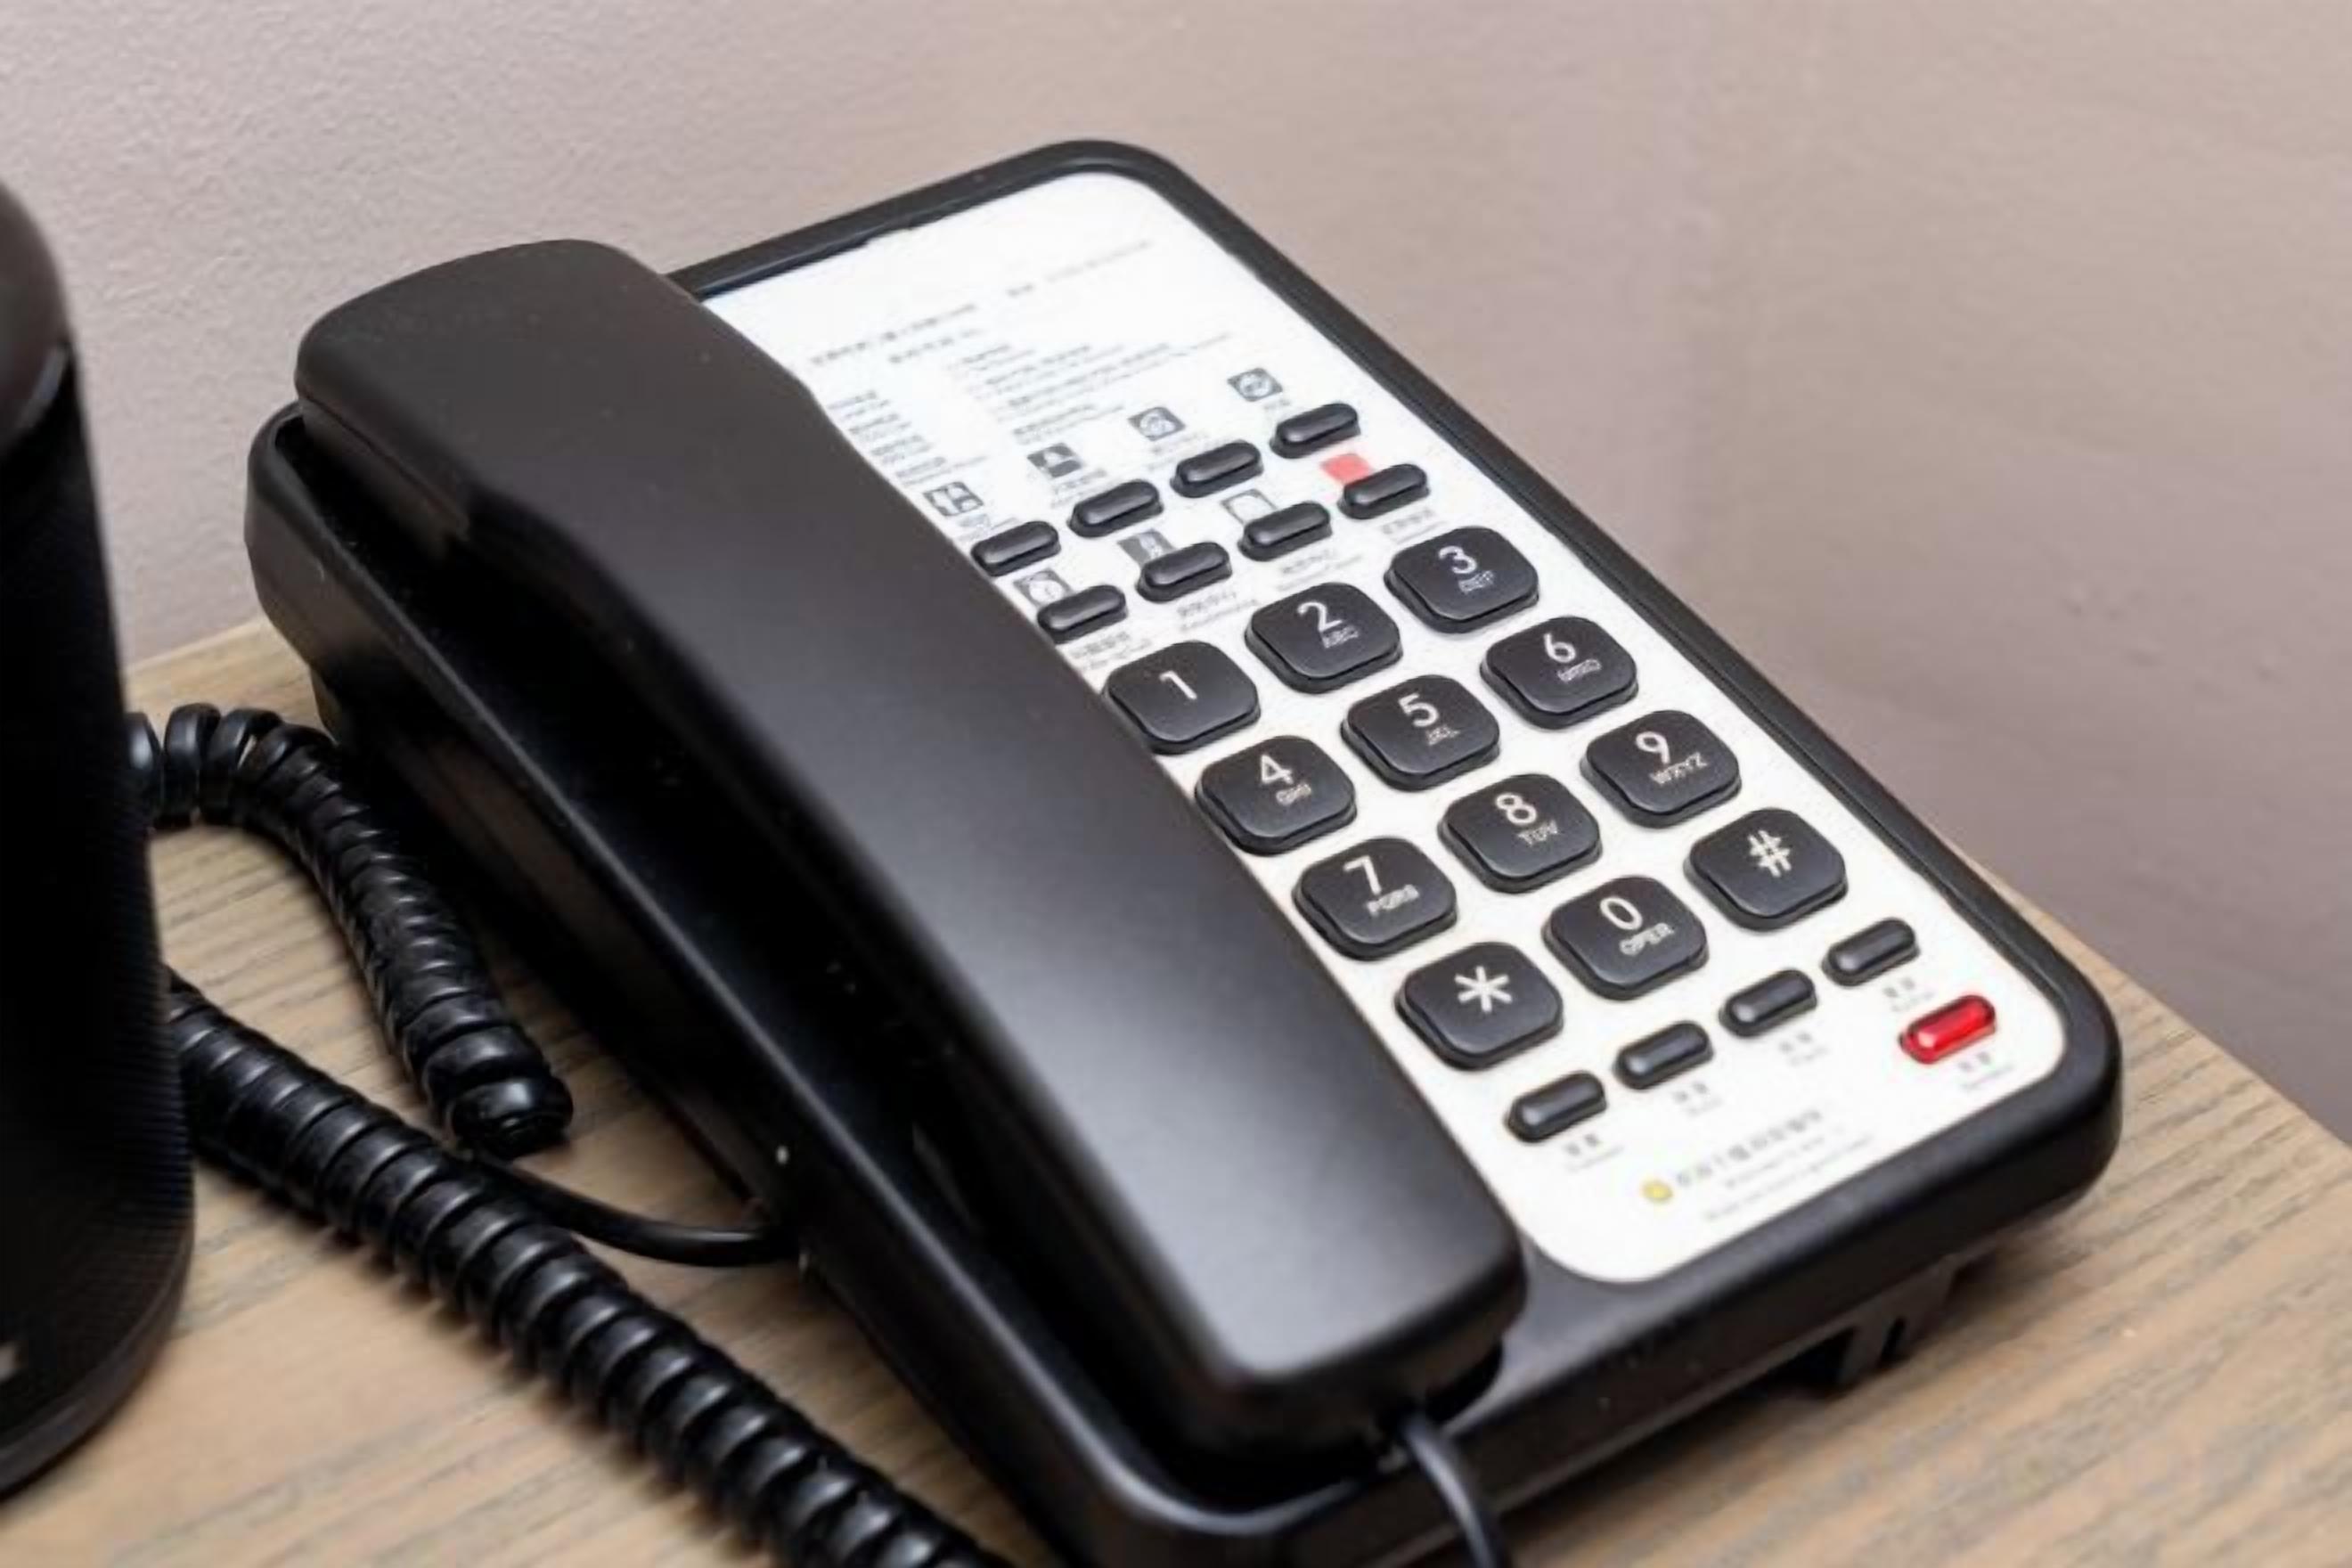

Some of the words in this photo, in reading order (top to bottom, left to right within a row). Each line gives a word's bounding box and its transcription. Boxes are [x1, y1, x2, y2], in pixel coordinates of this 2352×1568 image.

[1438, 545, 1478, 575] 3
[1297, 600, 1343, 633] 2
[1543, 633, 1577, 664] 6
[1159, 670, 1197, 700] 1
[1398, 693, 1440, 727] 5
[1636, 731, 1670, 764] 9
[1260, 754, 1294, 785] 4
[1650, 750, 1709, 785] WXYZ
[1495, 792, 1538, 826] 8
[1518, 821, 1560, 845] TUV
[1748, 829, 1792, 878] #
[1343, 855, 1382, 895] 7
[1599, 896, 1643, 931] 0
[1620, 921, 1676, 956] OPER
